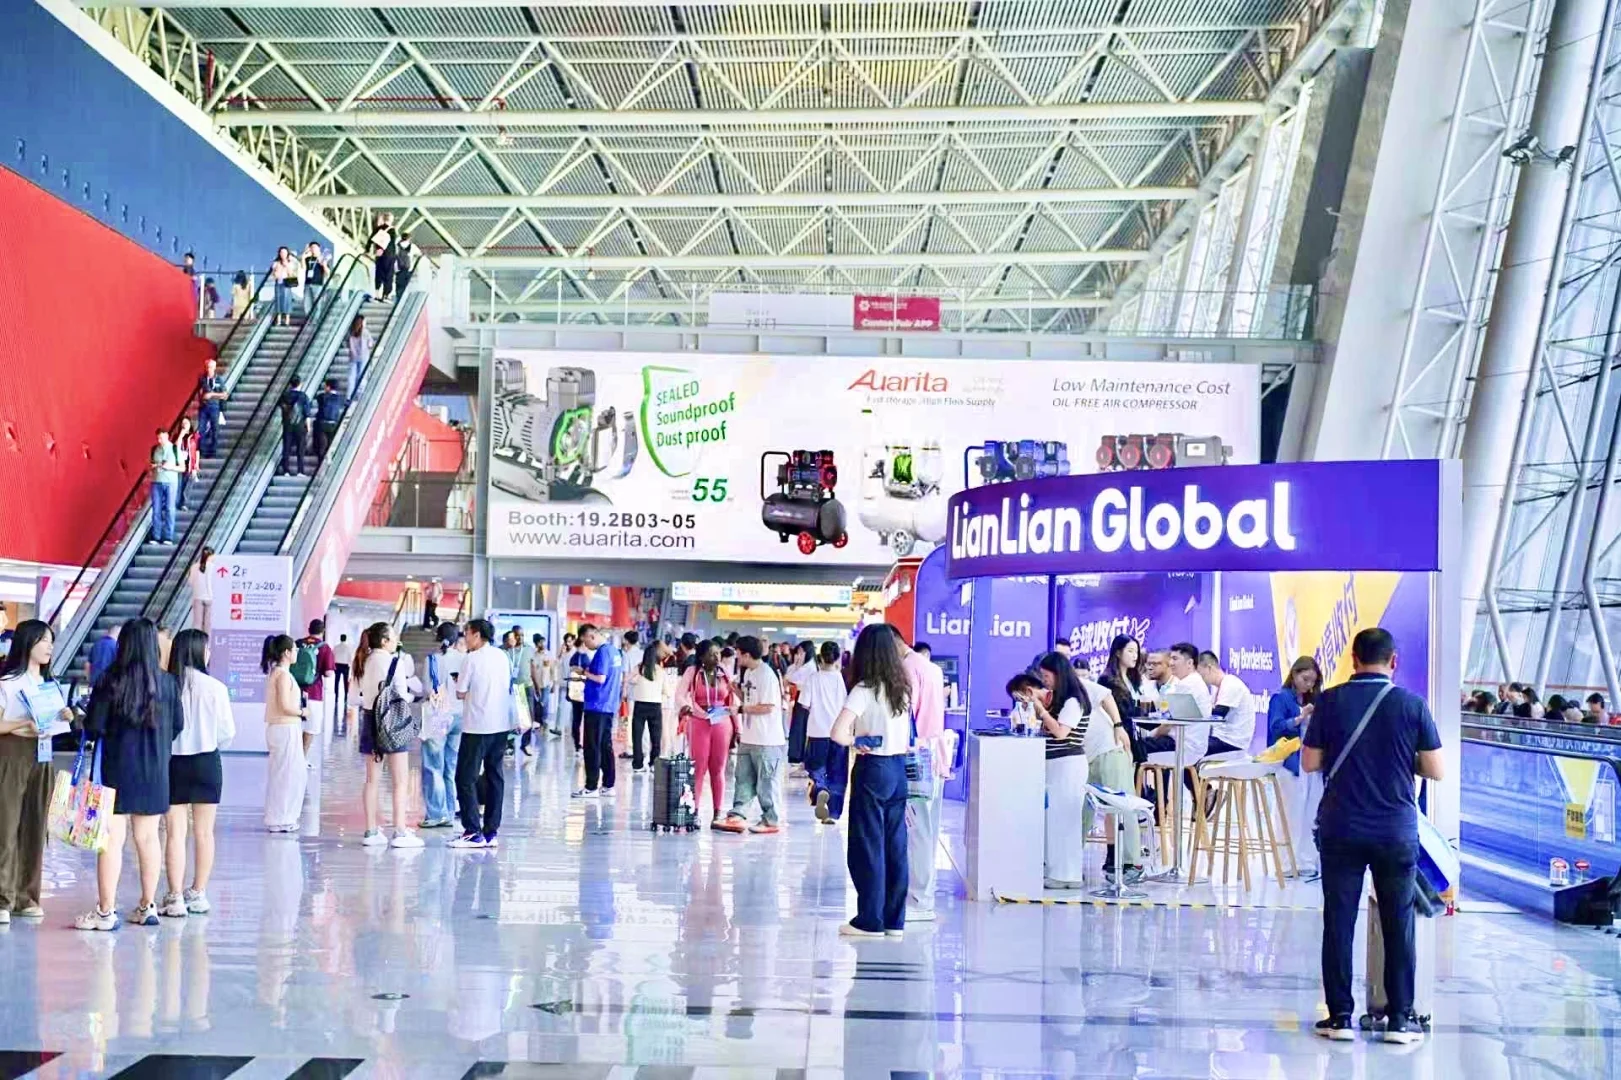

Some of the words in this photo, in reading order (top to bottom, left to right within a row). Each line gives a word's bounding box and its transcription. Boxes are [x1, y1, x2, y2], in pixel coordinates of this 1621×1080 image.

[656, 380, 700, 406] SEALED
[1053, 378, 1085, 392] Low
[1090, 379, 1192, 394] Maintenance
[1196, 380, 1231, 395] Cost
[656, 391, 736, 426] Soundproof
[966, 397, 996, 408] Supply
[1103, 398, 1121, 408] AIR
[1122, 399, 1198, 410] COMPRESSOR
[656, 431, 683, 448] Dust
[686, 420, 727, 449] proof
[691, 478, 728, 502] 55
[952, 493, 1082, 560] LianLian
[1091, 481, 1297, 553] Global
[509, 530, 695, 549] www.auarita.com
[1229, 648, 1240, 674] Pay
[1240, 645, 1273, 671] Borderless
